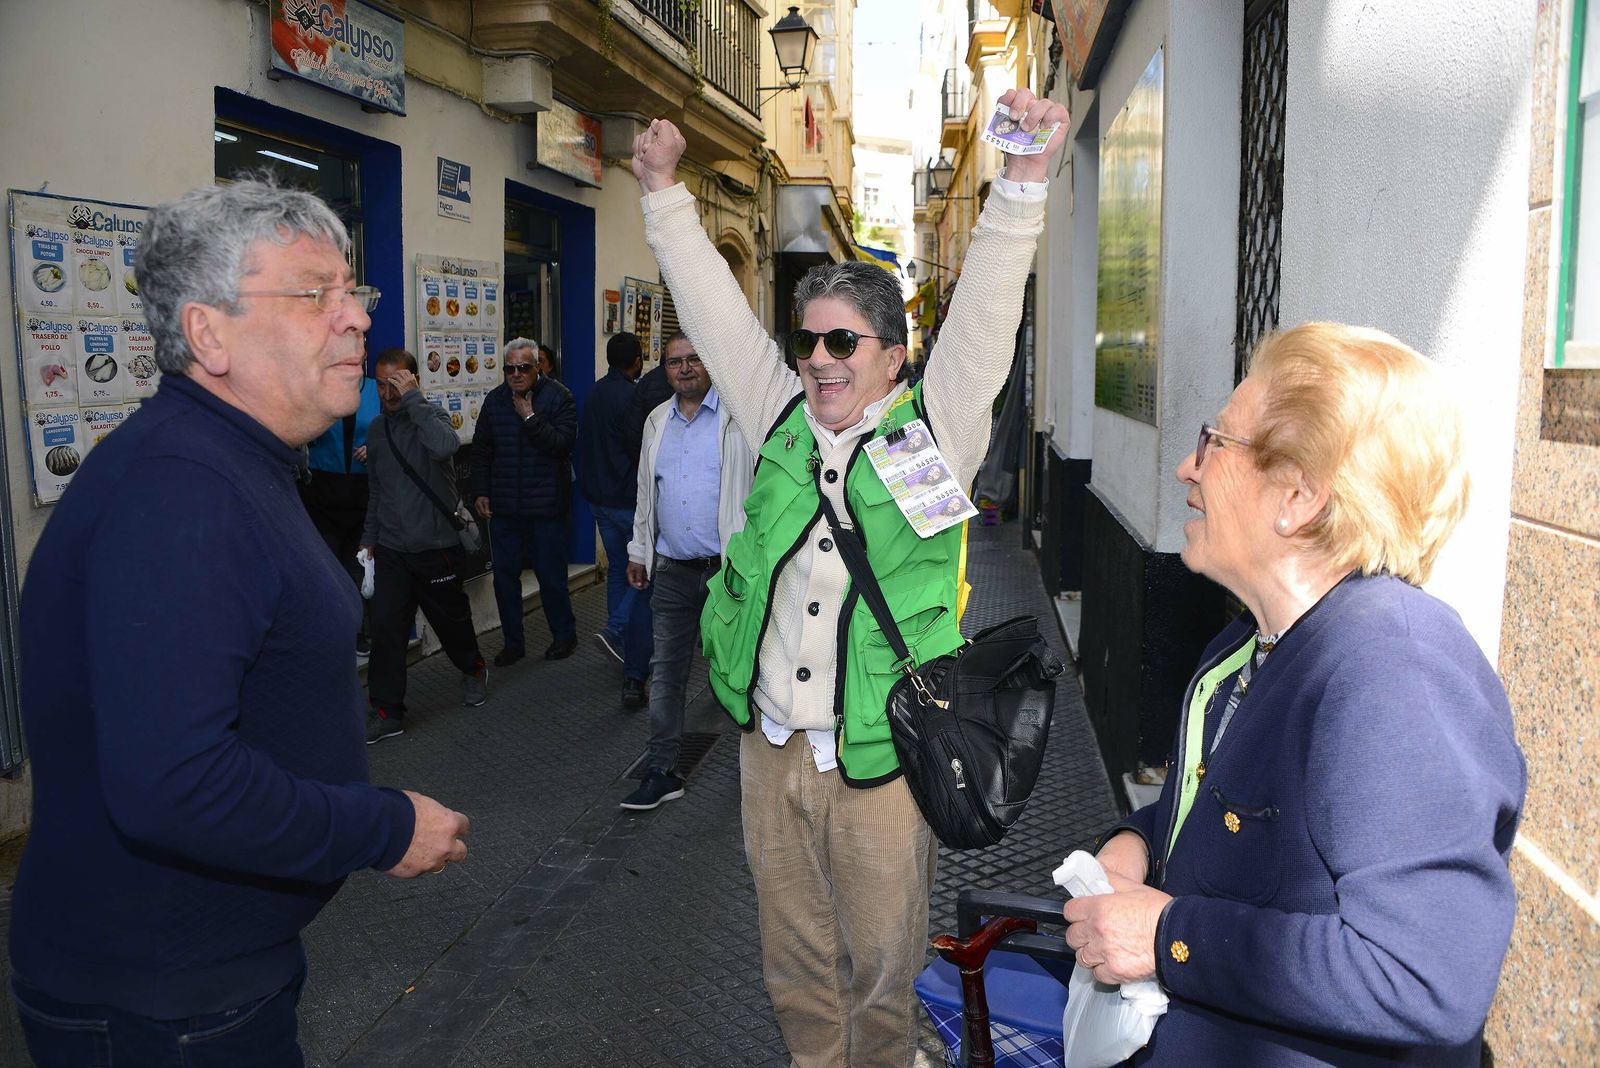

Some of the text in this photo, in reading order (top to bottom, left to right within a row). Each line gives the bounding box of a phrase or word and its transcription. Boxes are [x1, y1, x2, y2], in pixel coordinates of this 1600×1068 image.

[320, 3, 394, 62] Calypso
[985, 134, 1009, 150] 71453
[36, 227, 69, 242] Calypso
[83, 235, 114, 248] Calypso
[39, 320, 73, 333] Calypso
[87, 322, 118, 334] Calypso
[46, 413, 79, 425] Calypso
[93, 411, 124, 423] Calypso
[915, 454, 939, 469] 56506
[935, 486, 959, 501] 56506
